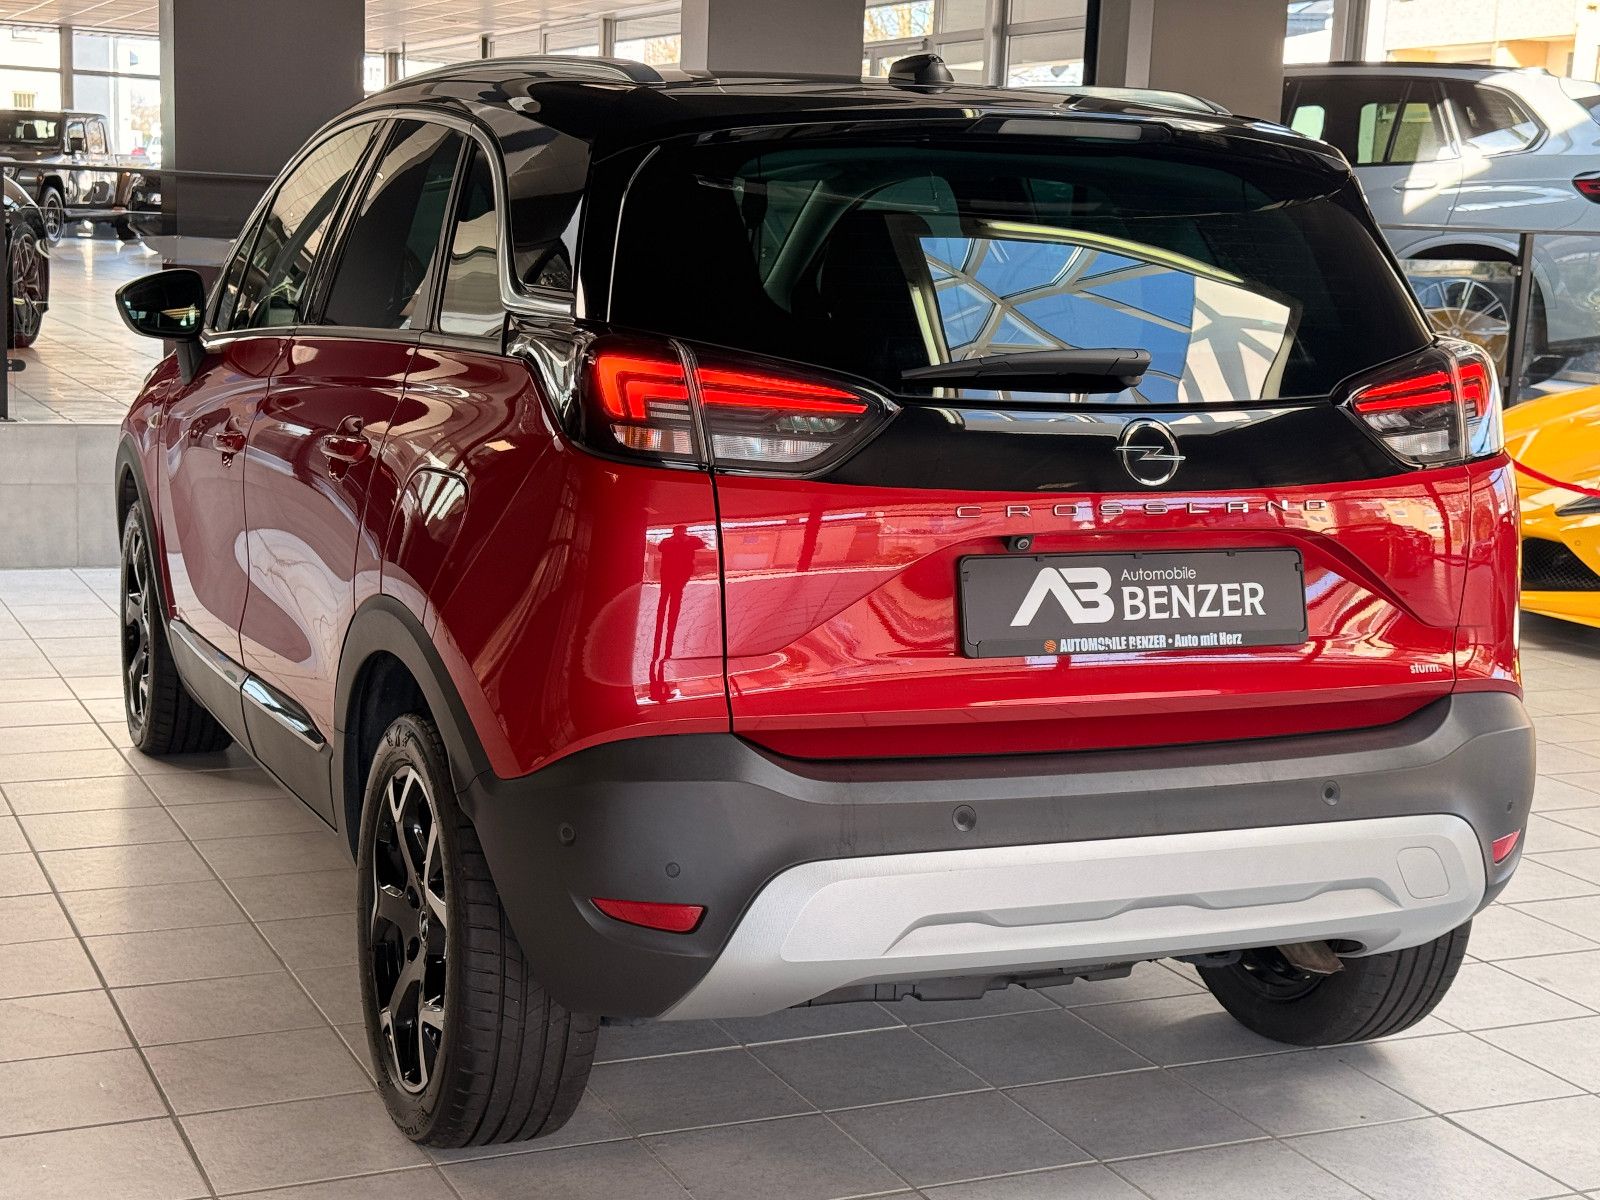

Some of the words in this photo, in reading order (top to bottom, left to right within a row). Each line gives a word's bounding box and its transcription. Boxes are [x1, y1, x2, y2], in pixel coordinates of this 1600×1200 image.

[956, 499, 1328, 518] CROSSLAND
[1120, 566, 1197, 582] Automobile
[1009, 566, 1116, 627] AB
[1121, 582, 1267, 621] BENZER
[1174, 633, 1199, 648] Auto
[1200, 632, 1219, 647] mit
[1219, 631, 1243, 646] Herz
